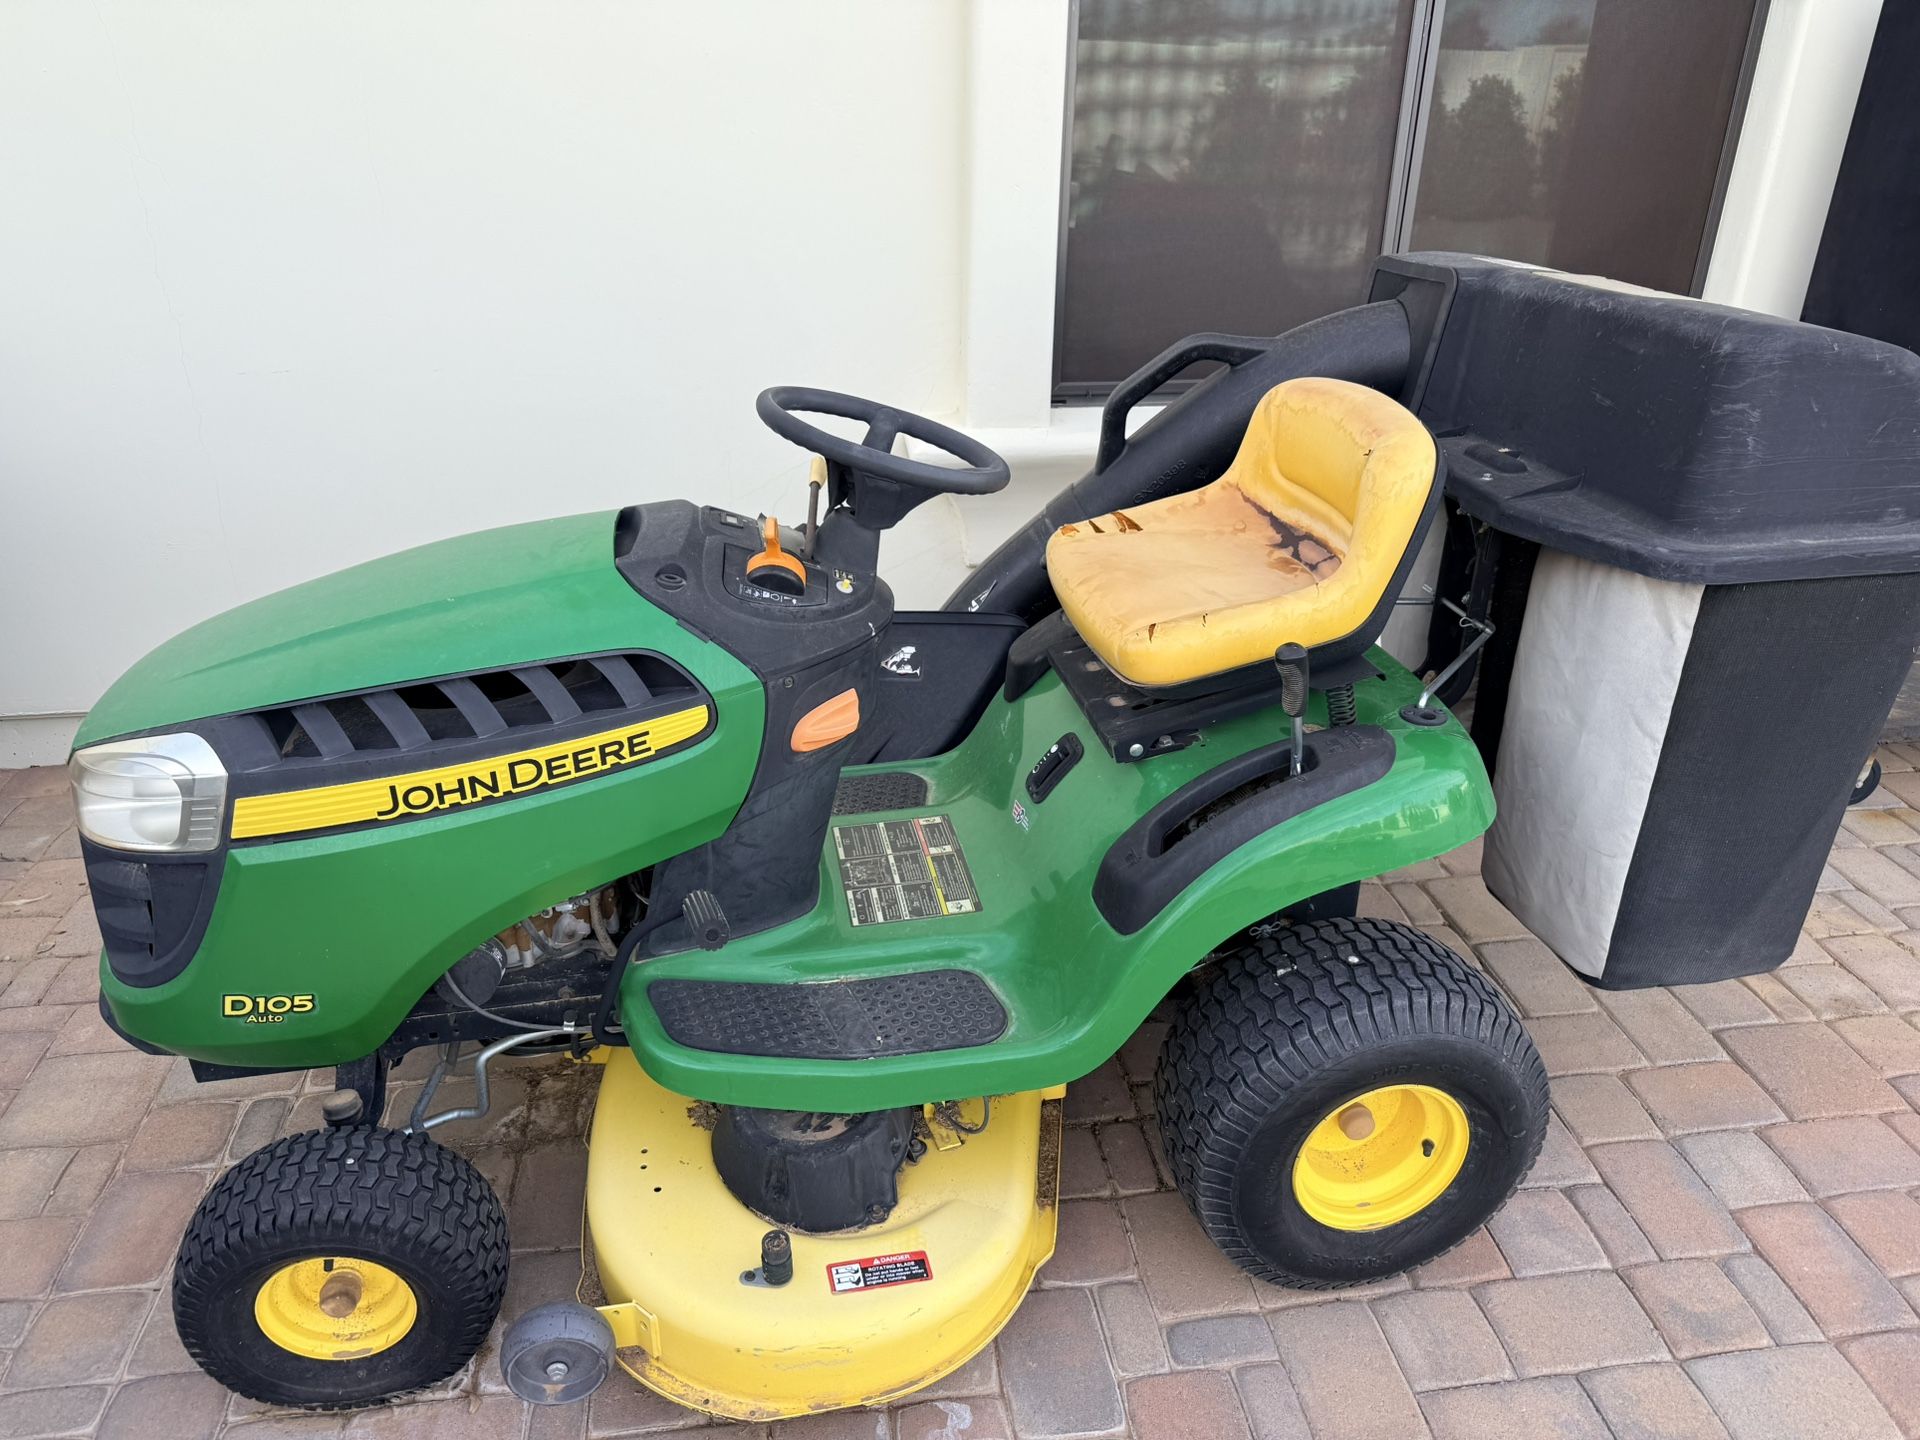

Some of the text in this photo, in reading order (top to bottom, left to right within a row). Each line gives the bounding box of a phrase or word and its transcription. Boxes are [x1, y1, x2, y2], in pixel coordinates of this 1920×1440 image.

[377, 730, 652, 817] JOHN DEERE
[223, 994, 314, 1016] D105
[246, 1014, 283, 1023] Auto
[880, 1254, 910, 1263] DANGER
